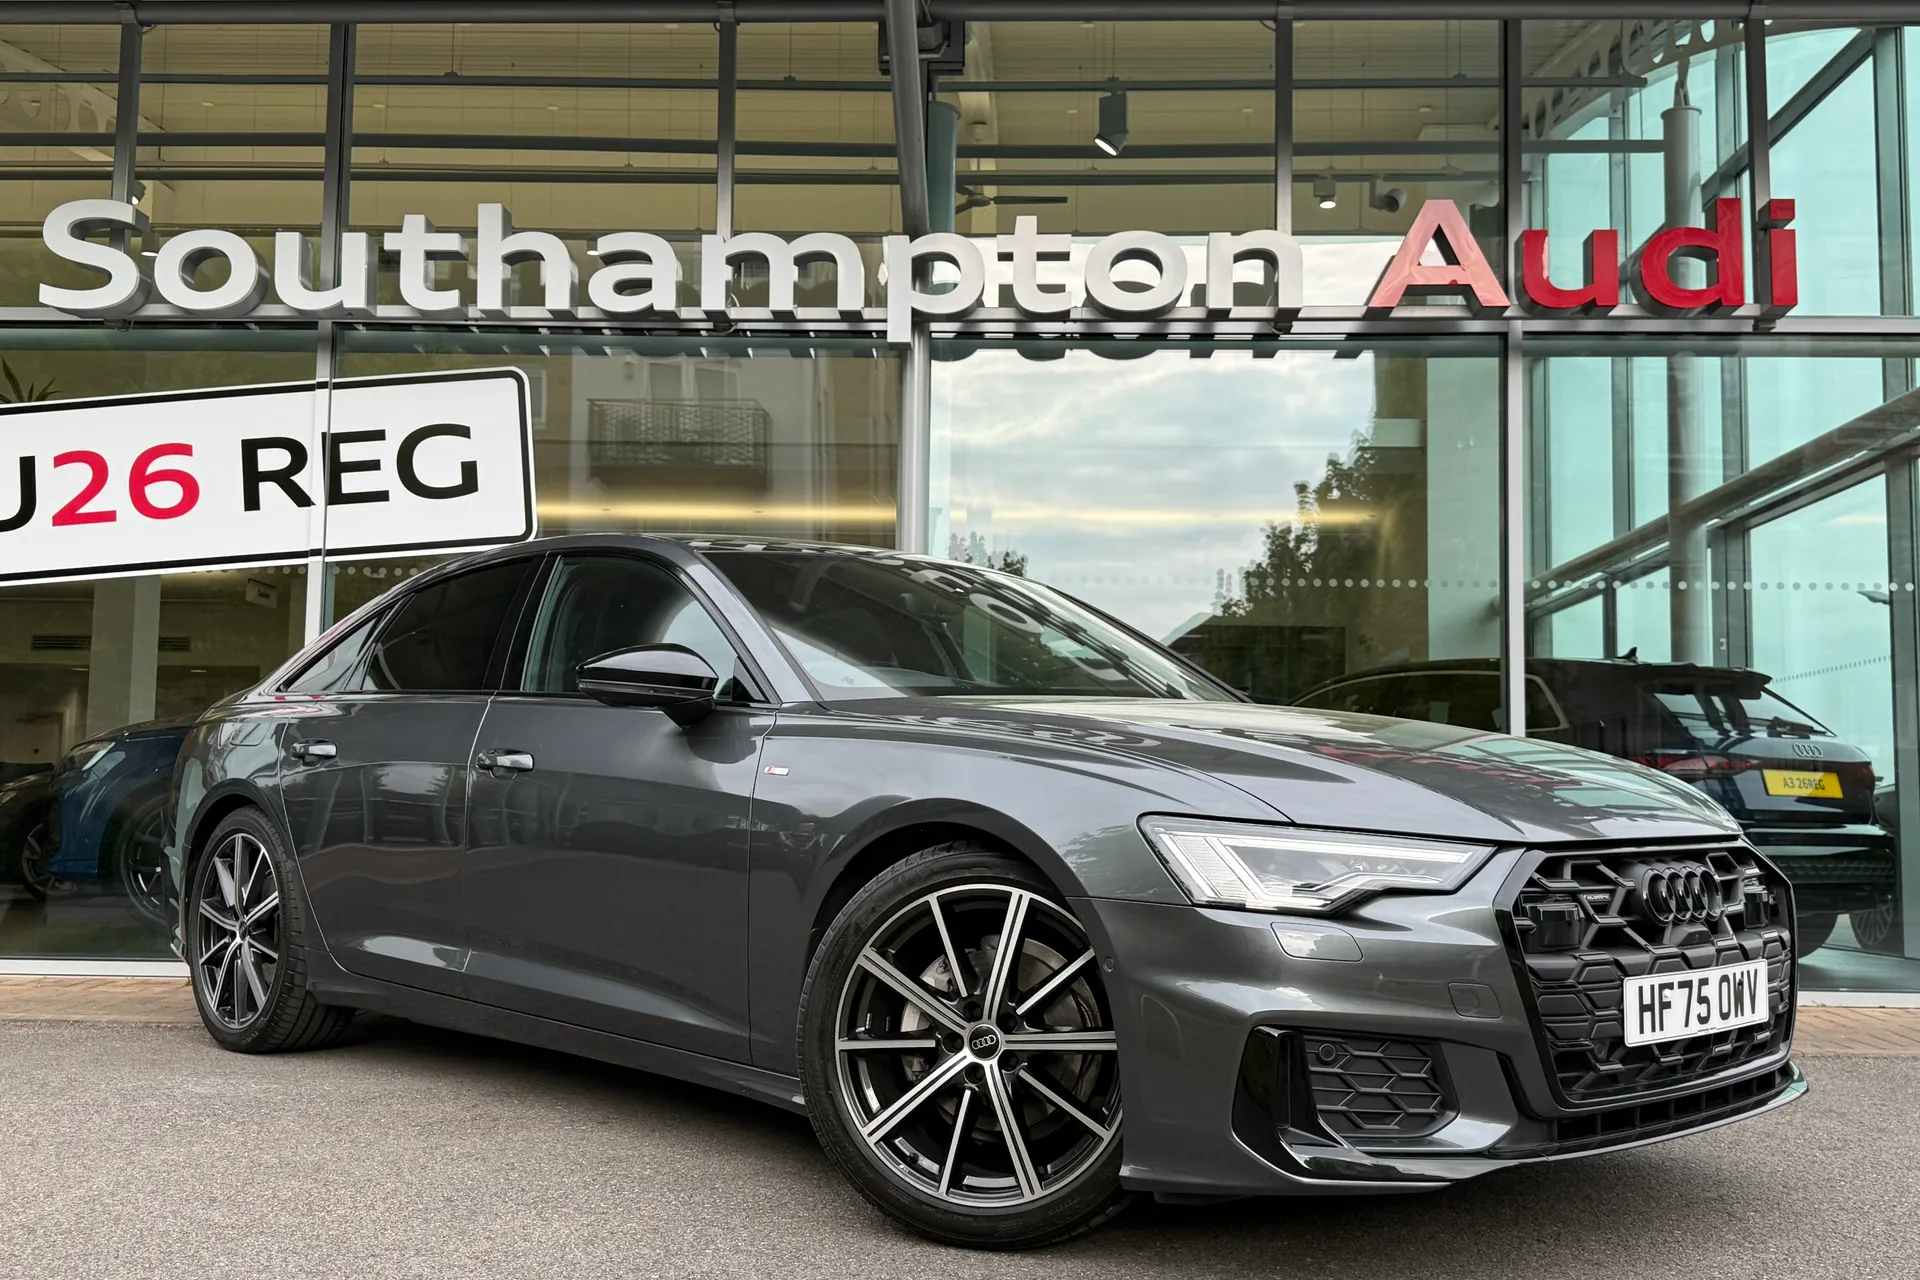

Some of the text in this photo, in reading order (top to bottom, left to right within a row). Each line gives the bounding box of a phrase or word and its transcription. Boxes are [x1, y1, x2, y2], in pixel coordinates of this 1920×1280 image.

[39, 198, 1798, 343] Southampton Audi
[241, 423, 479, 512] REG
[1783, 777, 1795, 789] A3
[1638, 968, 1758, 1035] HF75 OWV
